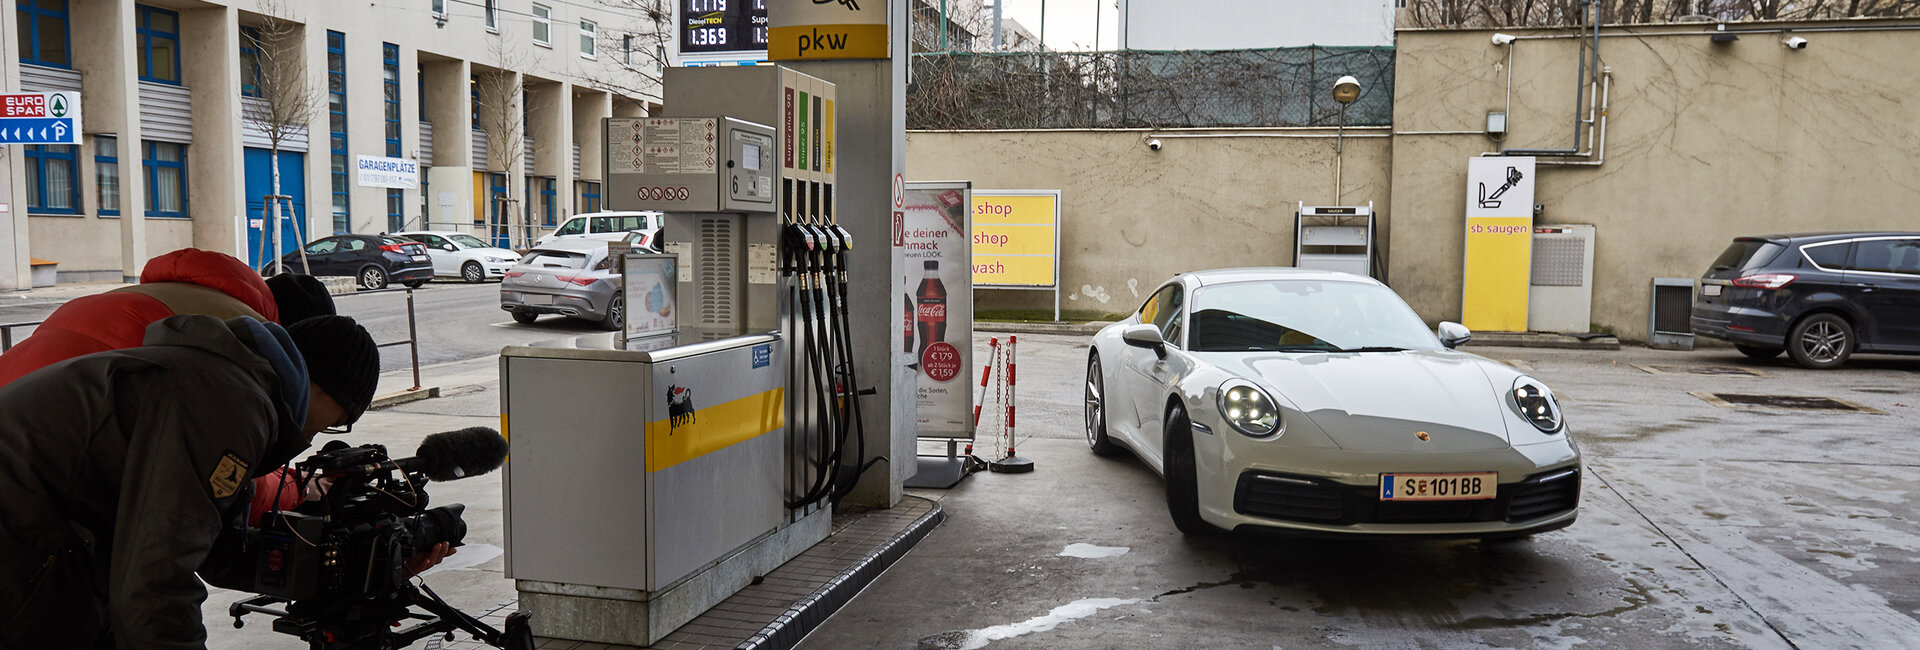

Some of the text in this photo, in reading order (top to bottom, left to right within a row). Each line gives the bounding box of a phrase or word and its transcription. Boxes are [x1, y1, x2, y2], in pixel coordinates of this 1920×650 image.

[692, 28, 726, 45] 1.369
[798, 28, 848, 56] pkw
[6, 96, 44, 106] EURO
[6, 106, 45, 116] SPAR
[359, 159, 416, 173] GARAGENPLÄTZE
[732, 175, 738, 194] 6
[977, 201, 1012, 217] shop
[913, 228, 948, 238] deinen
[1471, 223, 1528, 236] sb saugen
[973, 231, 1008, 247] shop
[939, 352, 952, 361] 1,79
[939, 369, 953, 378] 1,59
[1405, 478, 1416, 496] S
